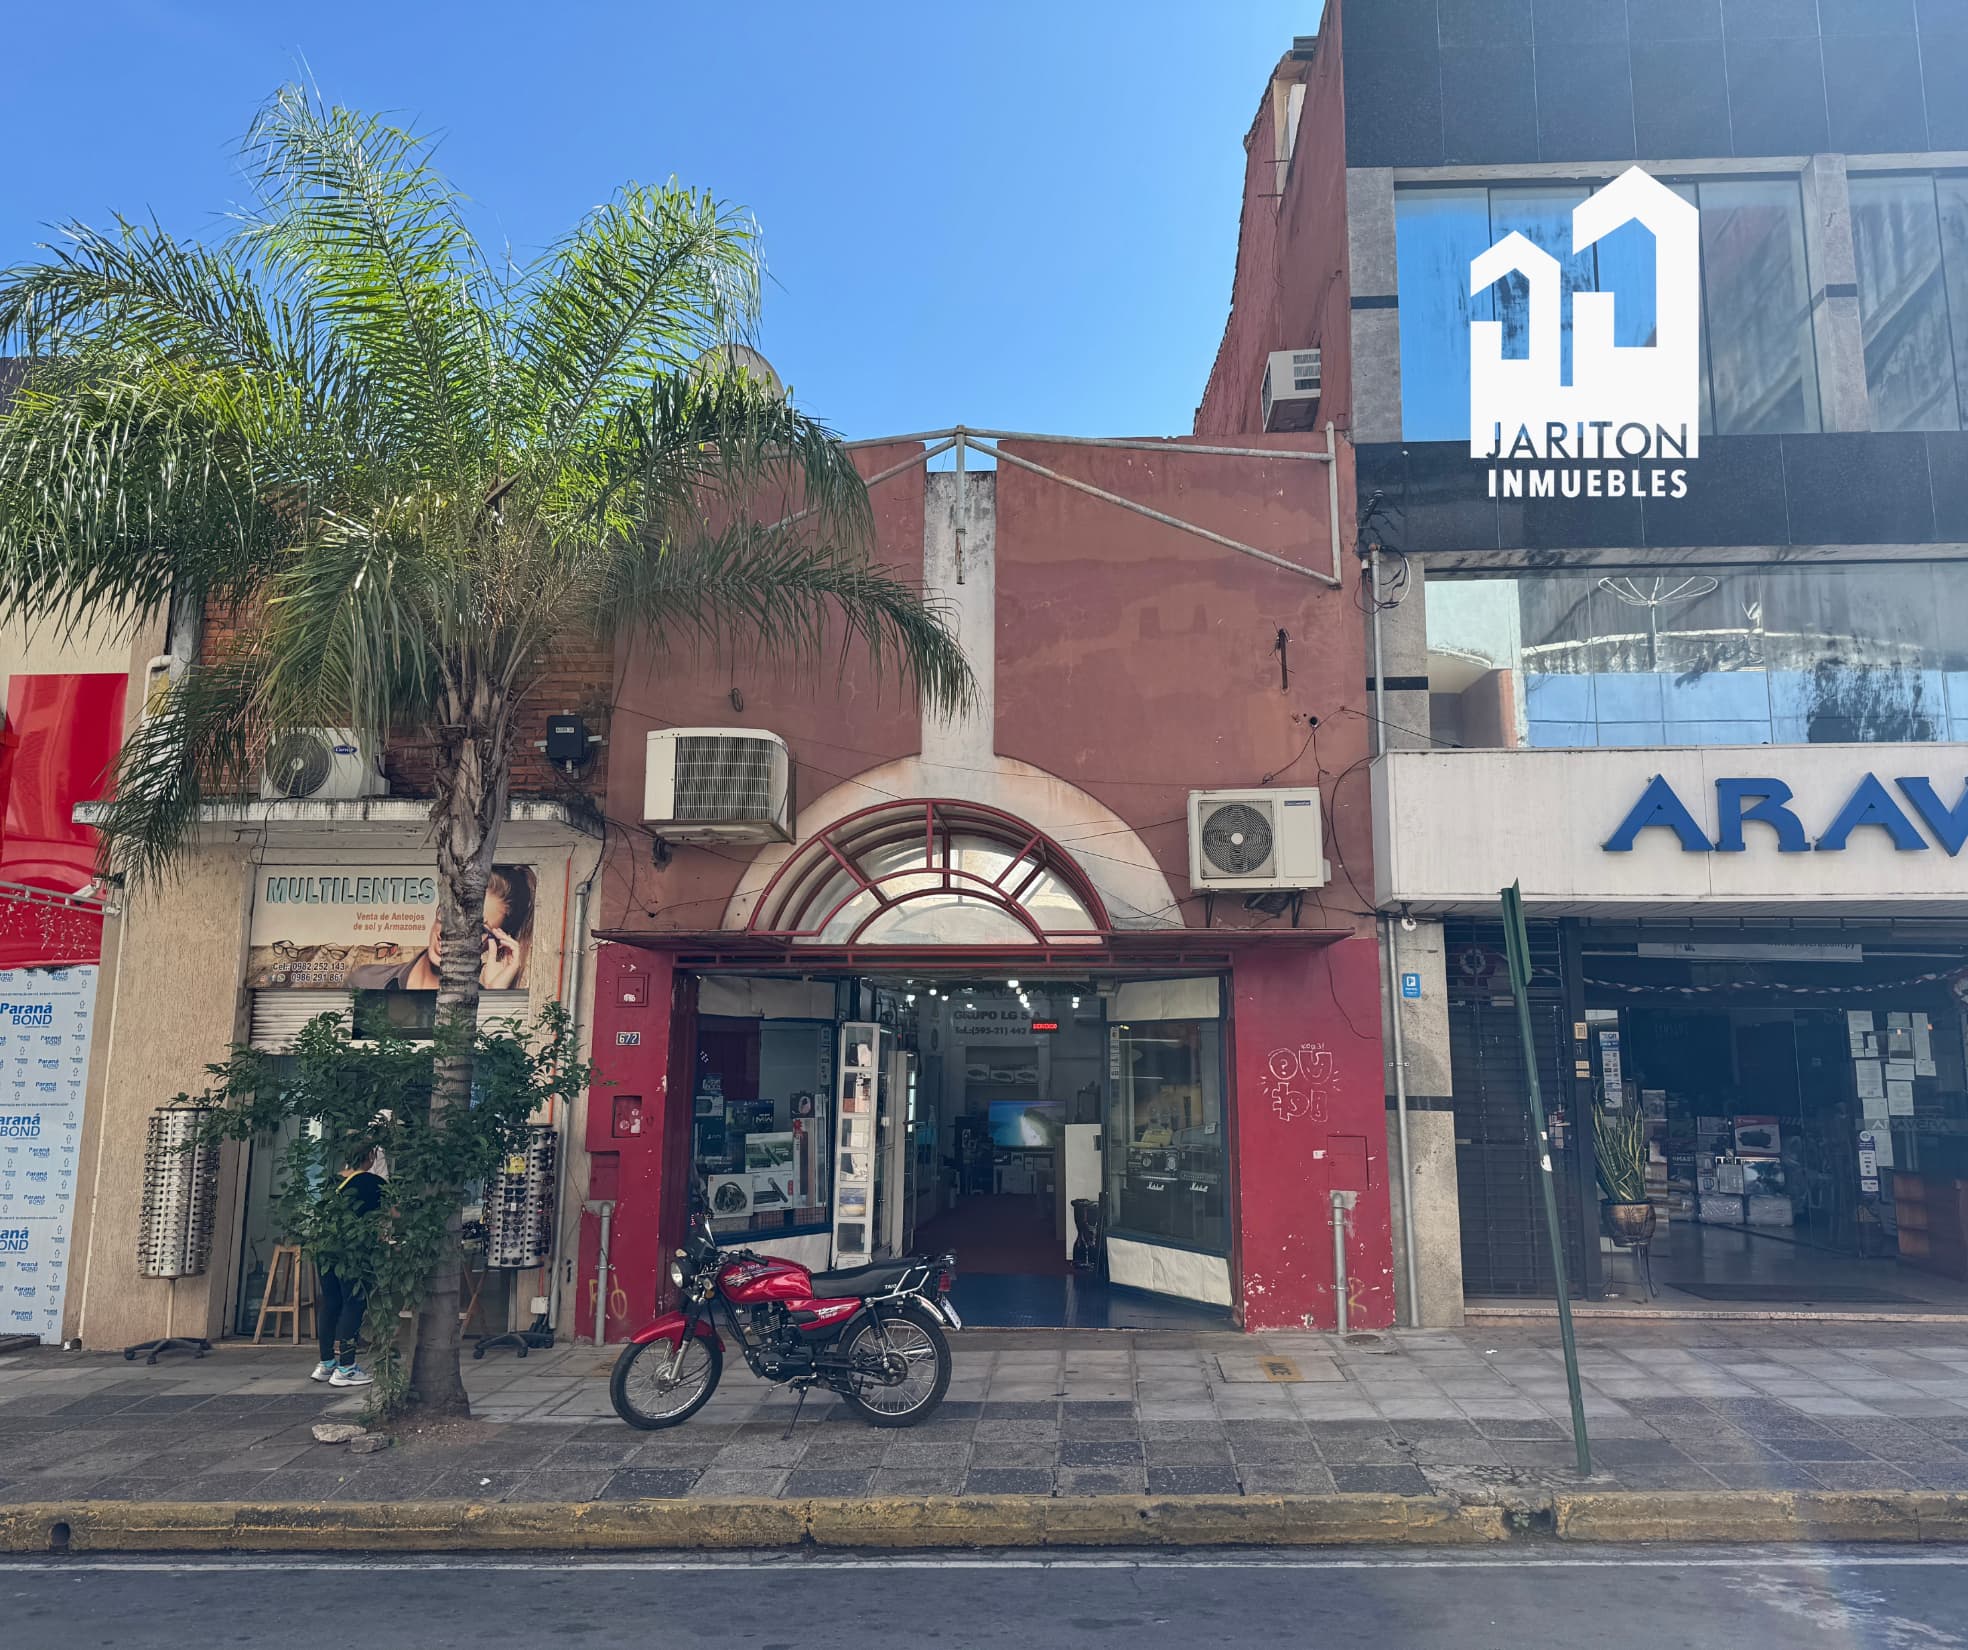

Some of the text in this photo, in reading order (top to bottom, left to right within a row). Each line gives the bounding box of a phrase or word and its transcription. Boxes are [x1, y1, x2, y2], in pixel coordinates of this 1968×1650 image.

[266, 877, 436, 904] MULTILENTES
[356, 912, 425, 922] Venta de Anteojos
[353, 922, 426, 932] de sol y Armazones
[292, 962, 312, 971] 0982
[313, 962, 329, 971] 252
[331, 962, 345, 971] 143
[291, 973, 311, 982] 0986
[312, 973, 327, 982] 291
[0, 1002, 53, 1015] Paraná
[12, 1015, 53, 1025] BOND
[954, 1011, 998, 1020] GRUPO
[1001, 1011, 1018, 1020] LG
[0, 1126, 41, 1136] BOND
